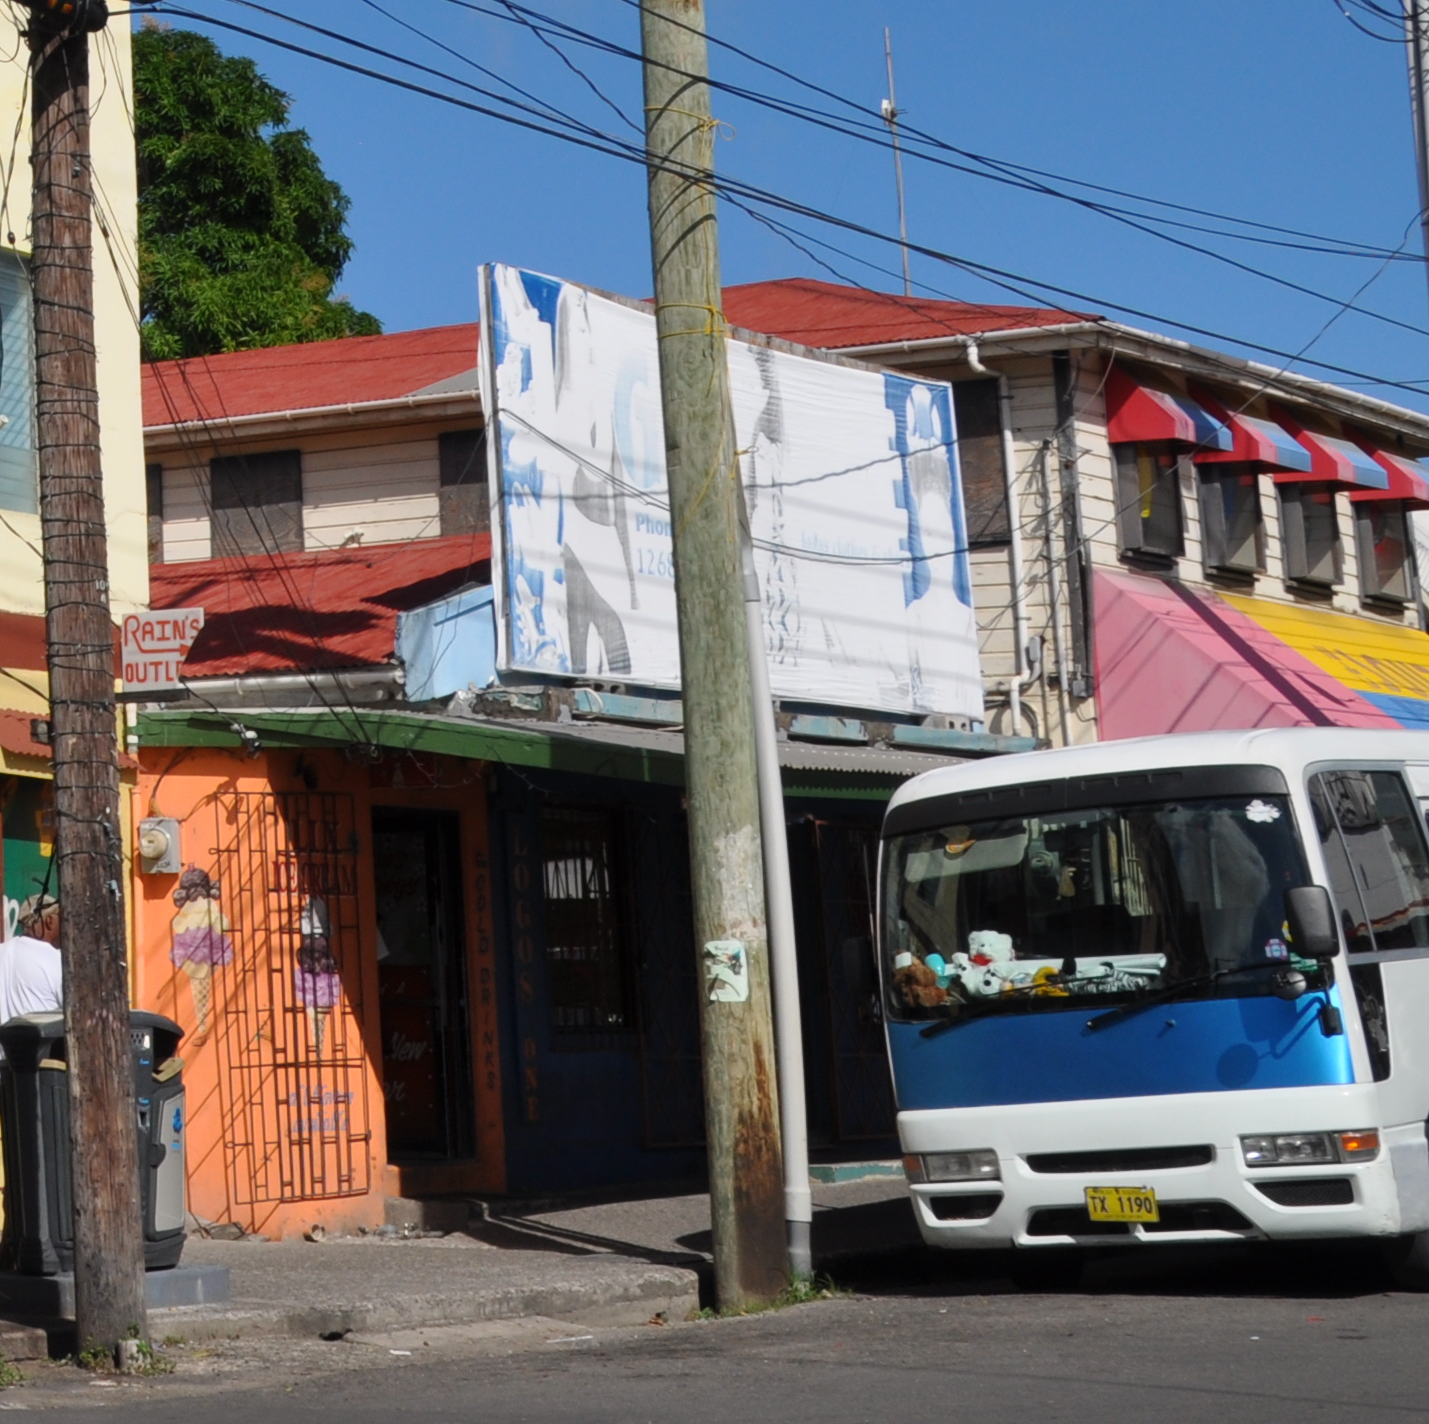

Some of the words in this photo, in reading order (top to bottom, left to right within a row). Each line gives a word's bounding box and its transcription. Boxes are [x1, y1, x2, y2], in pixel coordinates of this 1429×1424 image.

[635, 512, 673, 538] Phon
[124, 615, 201, 647] RAIN'S
[1090, 1196, 1109, 1213] TX
[1118, 1196, 1153, 1214] 1190
